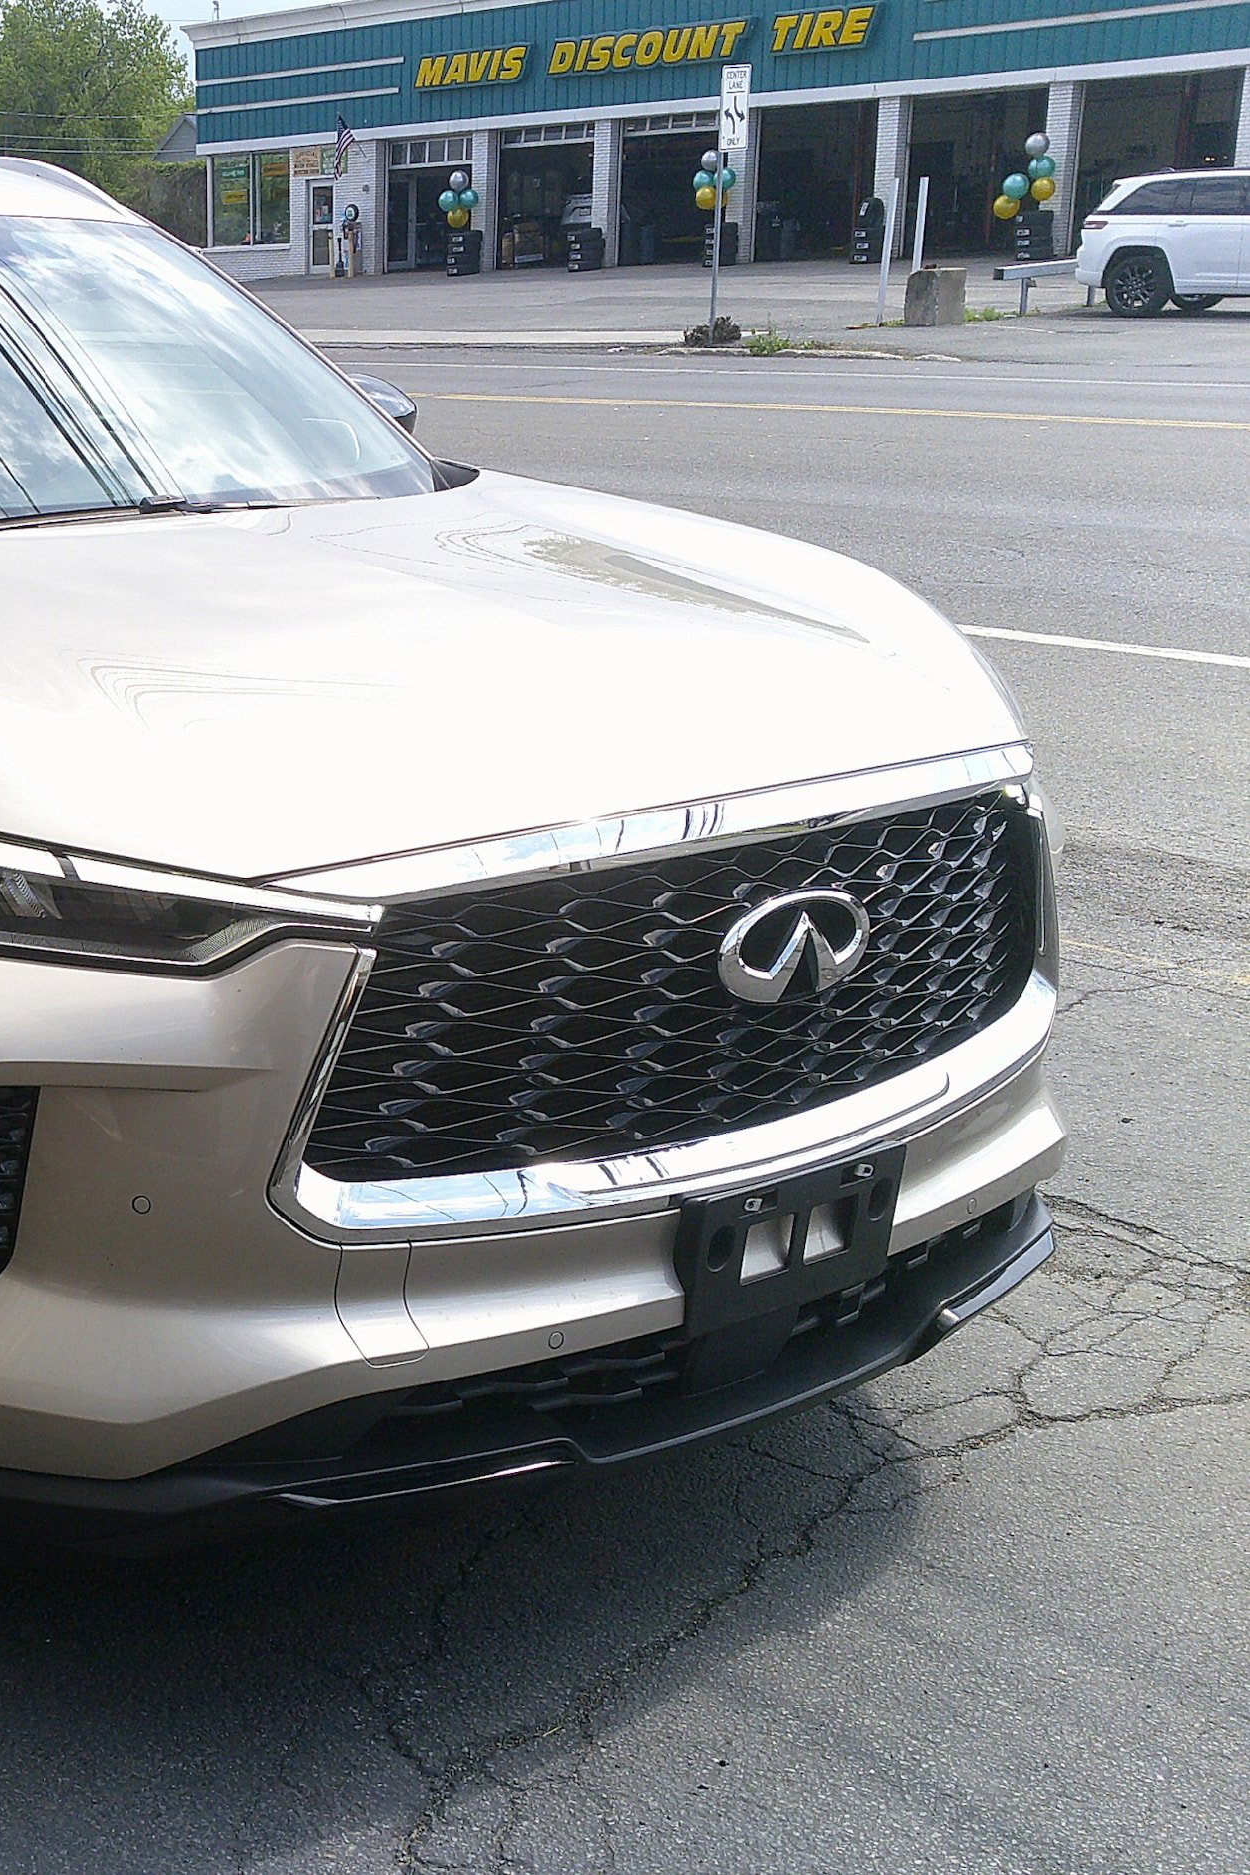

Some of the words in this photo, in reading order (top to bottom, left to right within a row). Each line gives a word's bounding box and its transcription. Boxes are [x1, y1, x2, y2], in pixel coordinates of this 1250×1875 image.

[415, 46, 527, 89] MAVIS
[549, 21, 747, 75] DISCOUNT
[771, 6, 874, 52] TIRE
[727, 70, 747, 79] CENTER
[729, 81, 743, 89] LANE
[726, 137, 740, 146] ONLY
